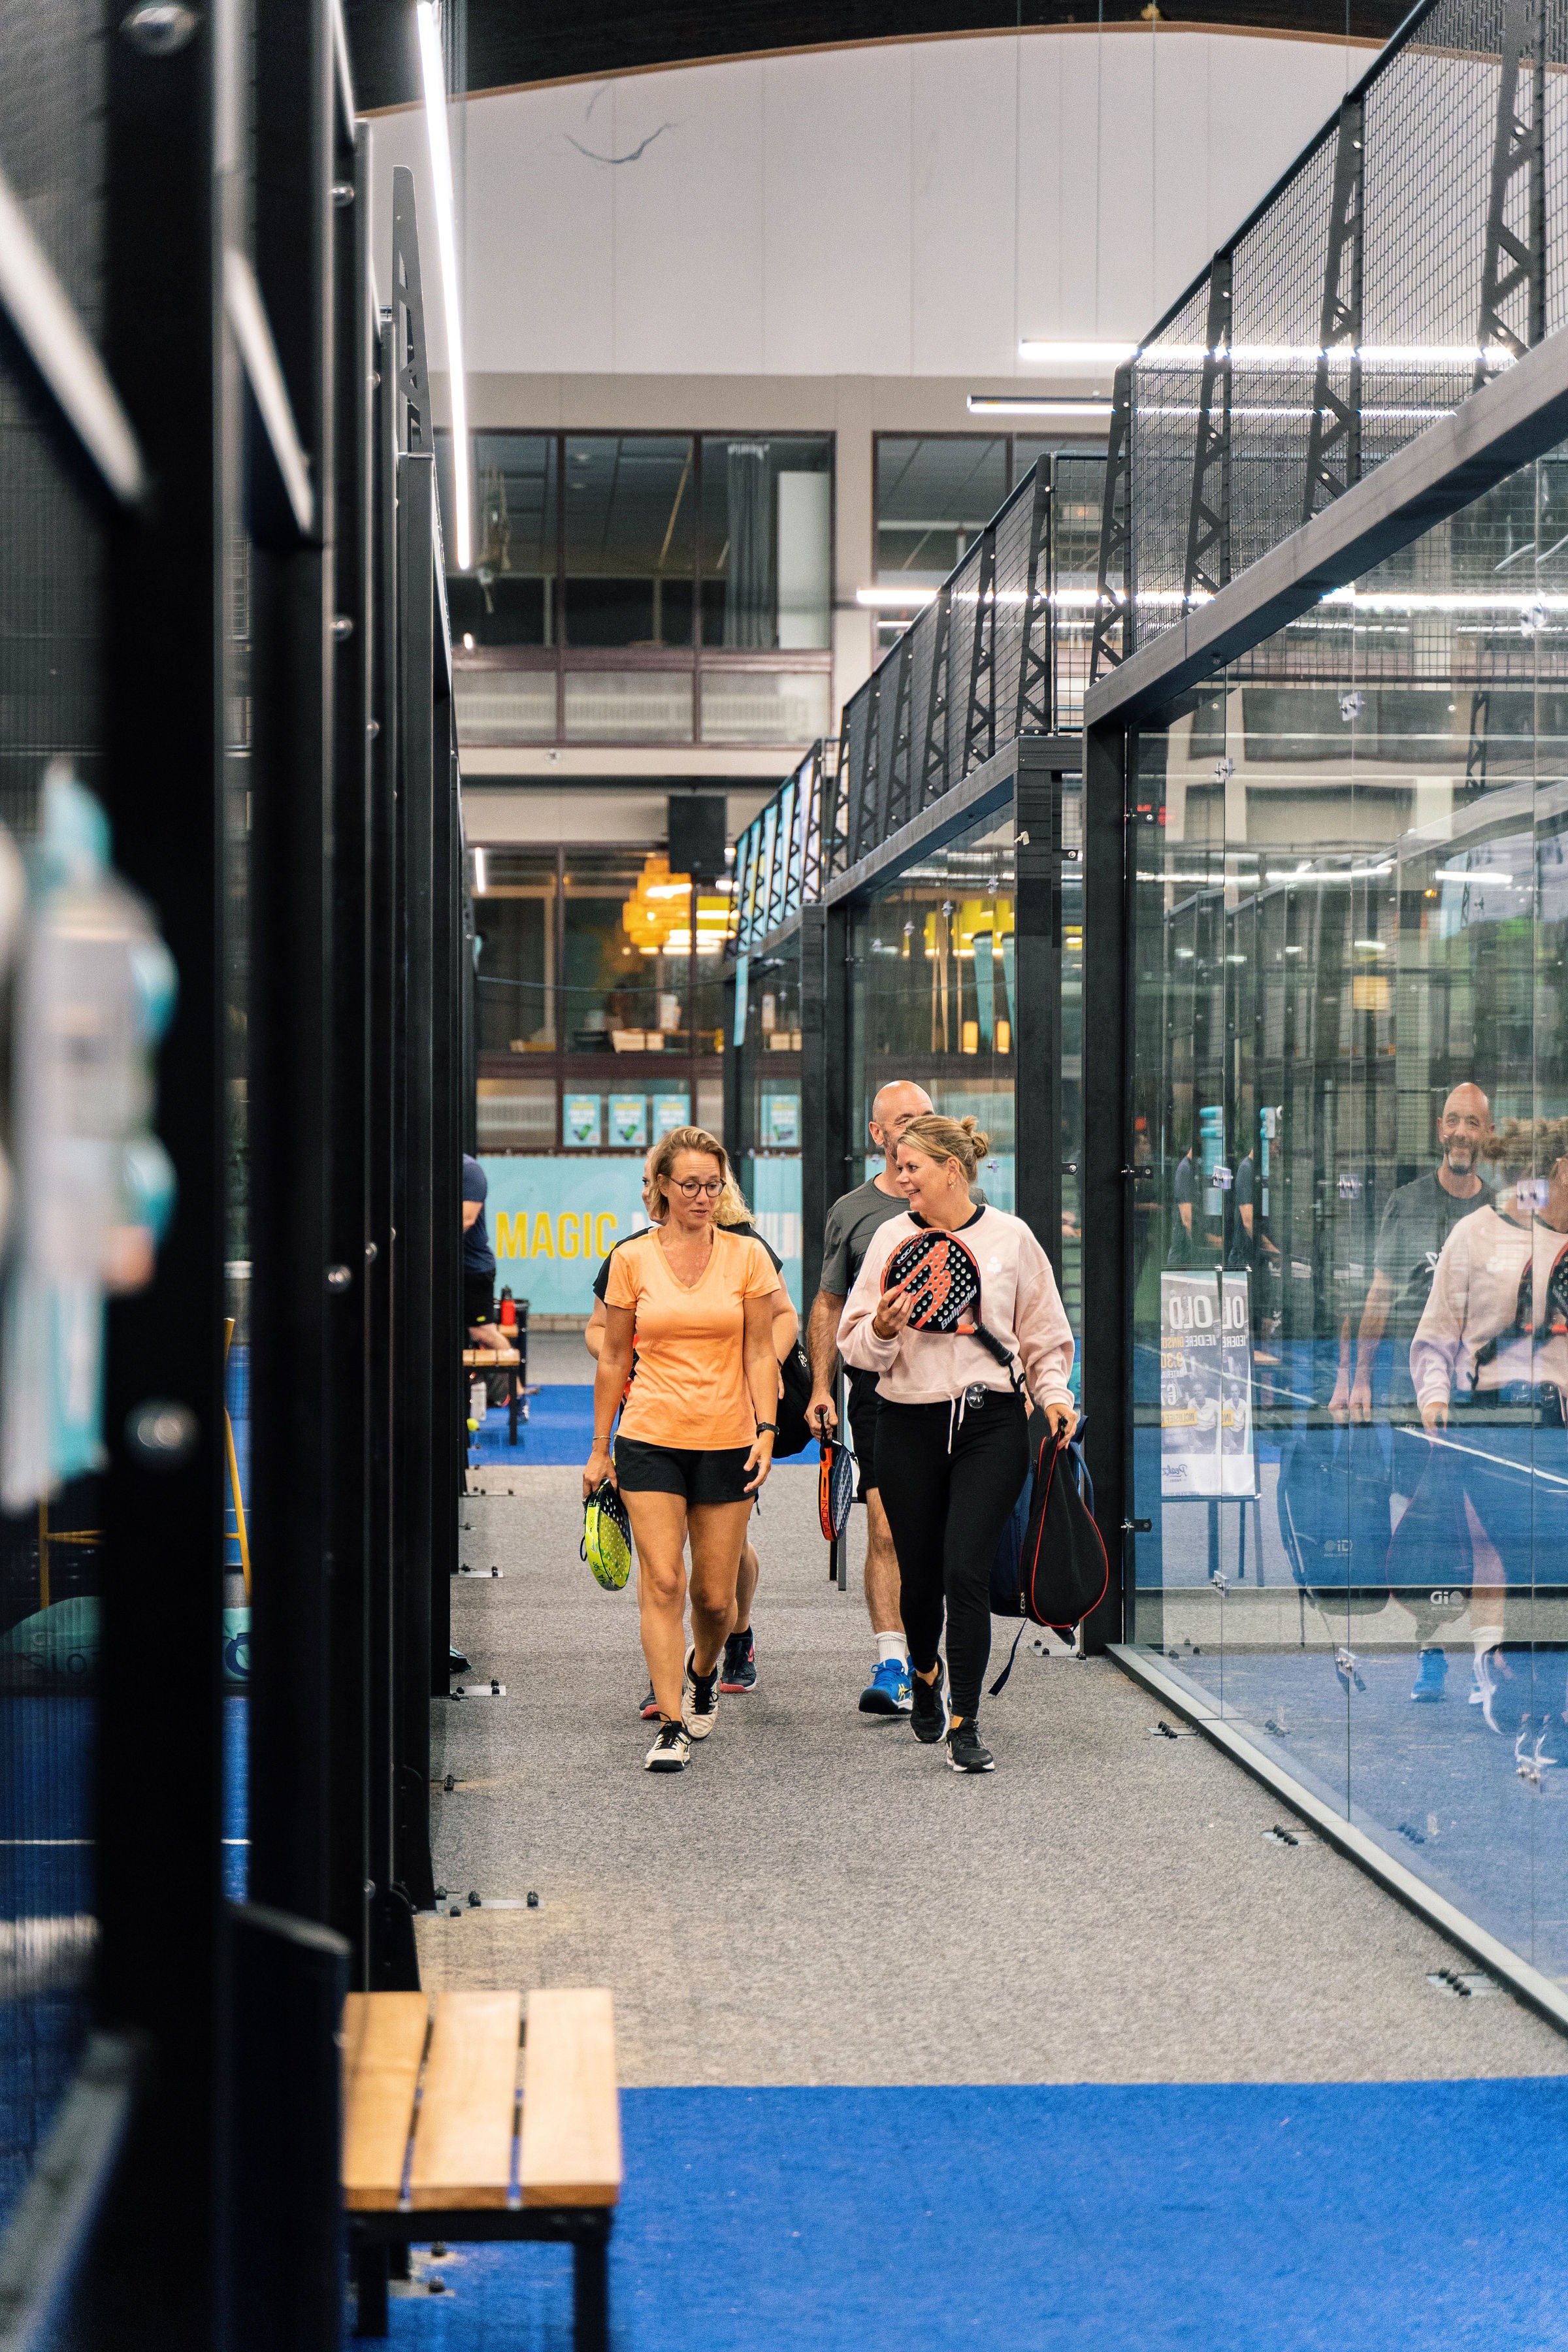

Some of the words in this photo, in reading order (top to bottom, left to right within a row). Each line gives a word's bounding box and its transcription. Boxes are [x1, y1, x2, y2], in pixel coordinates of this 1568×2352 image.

[495, 1212, 617, 1258] MAGIC
[941, 1284, 977, 1330] Bullpadel
[821, 1499, 830, 1533] INDIGA
